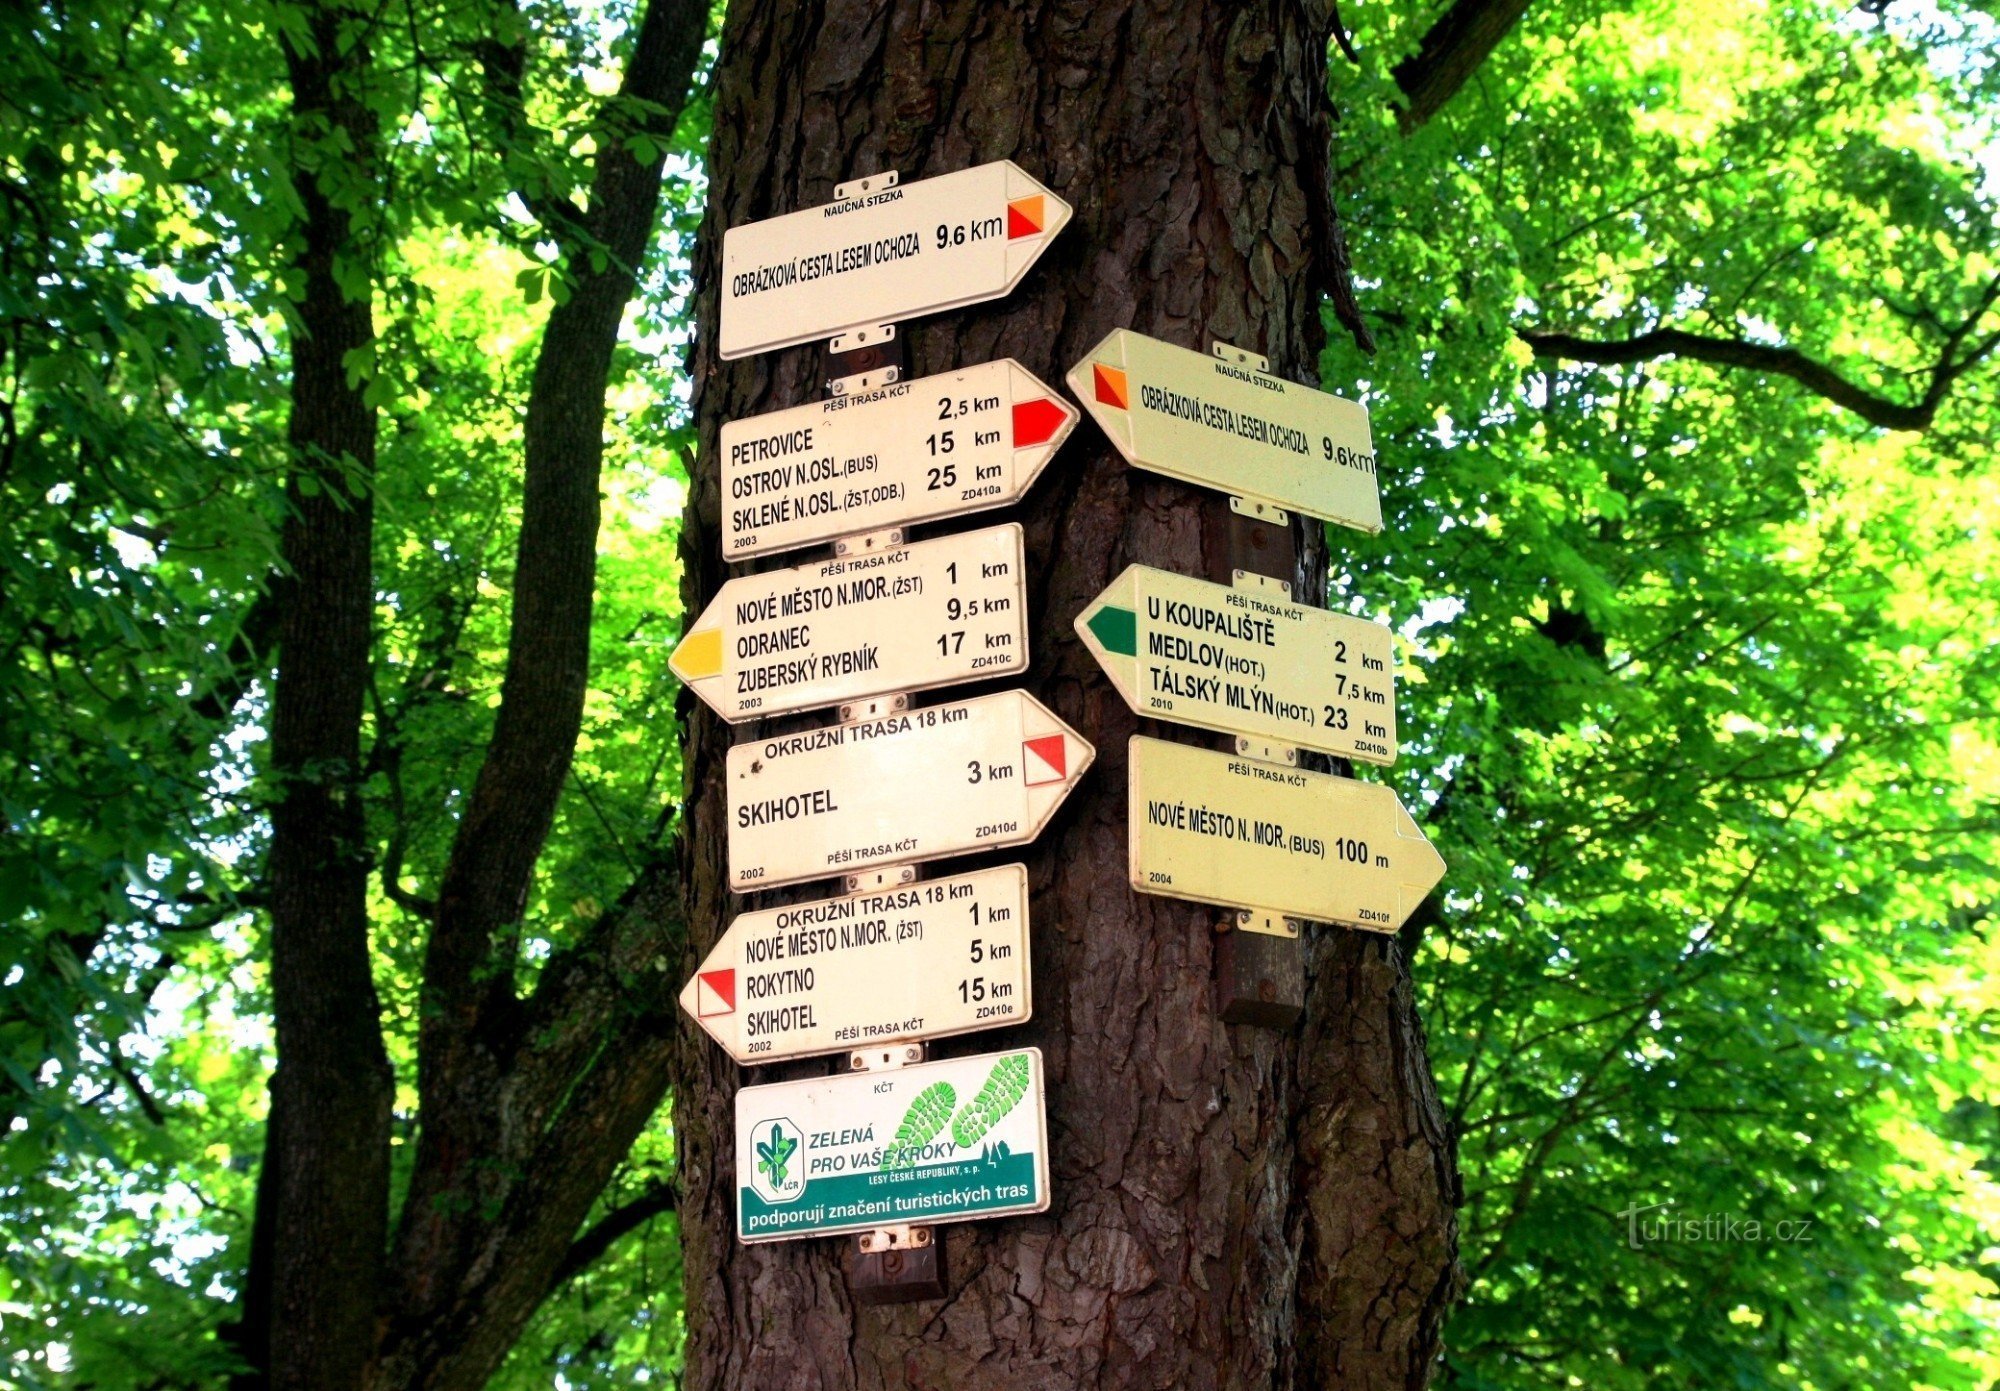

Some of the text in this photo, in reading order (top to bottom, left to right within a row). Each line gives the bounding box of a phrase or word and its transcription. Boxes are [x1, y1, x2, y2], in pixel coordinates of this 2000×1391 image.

[824, 189, 903, 218] NAUČNÁ STEZKA
[733, 257, 797, 298] OBRÁZKOVÁ
[800, 253, 833, 281] CESTA
[836, 244, 871, 274] LESEM
[874, 232, 920, 264] OCHOZA
[971, 216, 1002, 242] km
[1215, 364, 1285, 394] NAUČNÁ STEZKA
[823, 384, 911, 413] PĚŠÍ TRASA KČT
[732, 395, 999, 467] PETROVICE 2,5 km
[1142, 384, 1203, 424] OBRÁZKOVÁ
[1204, 406, 1235, 433] CESTA
[1237, 414, 1268, 444] LESEM
[1270, 423, 1310, 456] OCHOZA
[732, 466, 792, 499] OSTROV
[926, 431, 954, 456] 15
[975, 429, 1000, 447] km
[733, 495, 790, 532] SKLENÉ
[927, 465, 957, 491] 25
[976, 463, 1002, 481] km
[961, 485, 1001, 501] ZD410a
[734, 535, 757, 548] 2003
[821, 551, 909, 578] PĚŠÍ TRASA KČT
[737, 593, 777, 625] NOVÉ
[781, 587, 832, 616] MĚSTO
[946, 562, 958, 584] 1
[982, 562, 1008, 579] km
[1226, 595, 1303, 621] PĚŠÍ TRASA KČT
[737, 597, 1010, 658] ODRANEC 9,5 km
[1148, 596, 1383, 671] U KOUPALIŠTĚ 2 km
[738, 631, 1011, 693] ZUBERSKÝ RYBNÍK 17 km
[971, 653, 1012, 669] ZD410c
[1150, 666, 1221, 703] TÁLSKÝ
[1324, 706, 1348, 730] 23
[1365, 720, 1386, 738] km
[1151, 697, 1173, 710] 2010
[1335, 674, 1360, 700] 7,5
[1364, 686, 1385, 704] km
[739, 698, 762, 710] 2003
[765, 707, 968, 759] OKRUŽNÍ TRASA 18 km
[1355, 740, 1387, 756] ZD410b
[1228, 763, 1307, 788] PĚŠÍ TRASA KČT
[738, 760, 1013, 828] SKIHOTEL 3 km
[975, 822, 1017, 838] ZD410d
[1149, 800, 1185, 830] NOVÉ
[1189, 805, 1234, 839] MĚSTO
[1289, 835, 1325, 860] (BUS)
[1336, 837, 1368, 864] 100
[1376, 854, 1388, 868] m
[828, 838, 918, 864] PĚŠÍ TRASA KČT
[740, 867, 764, 880] 2002
[1150, 872, 1172, 885] 2004
[777, 882, 973, 929] OKRUŽNÍ TRASA 18 km
[1359, 909, 1389, 923] ZD410f
[746, 902, 1010, 964] NOVÉ MĚSTO N.MOR. (ŽST) 1 km
[747, 939, 1011, 999] ROKYTNO 5 km
[747, 978, 1012, 1036] SKIHOTEL 15 km
[976, 1003, 1013, 1019] ZD410e
[835, 1018, 924, 1041] PĚŠÍ TRASA KČT
[748, 1040, 772, 1052] 2002
[874, 1082, 893, 1094] KČT
[809, 1123, 874, 1149] ZELENÁ
[811, 1142, 957, 1173] PRO VAŠE KROKY
[784, 1178, 799, 1191] LČR
[869, 1174, 888, 1185] LESY
[890, 1169, 915, 1182] ČESKÉ
[917, 1166, 962, 1180] REPUBLIKY,
[749, 1183, 1028, 1230] podporují značení turistických tras
